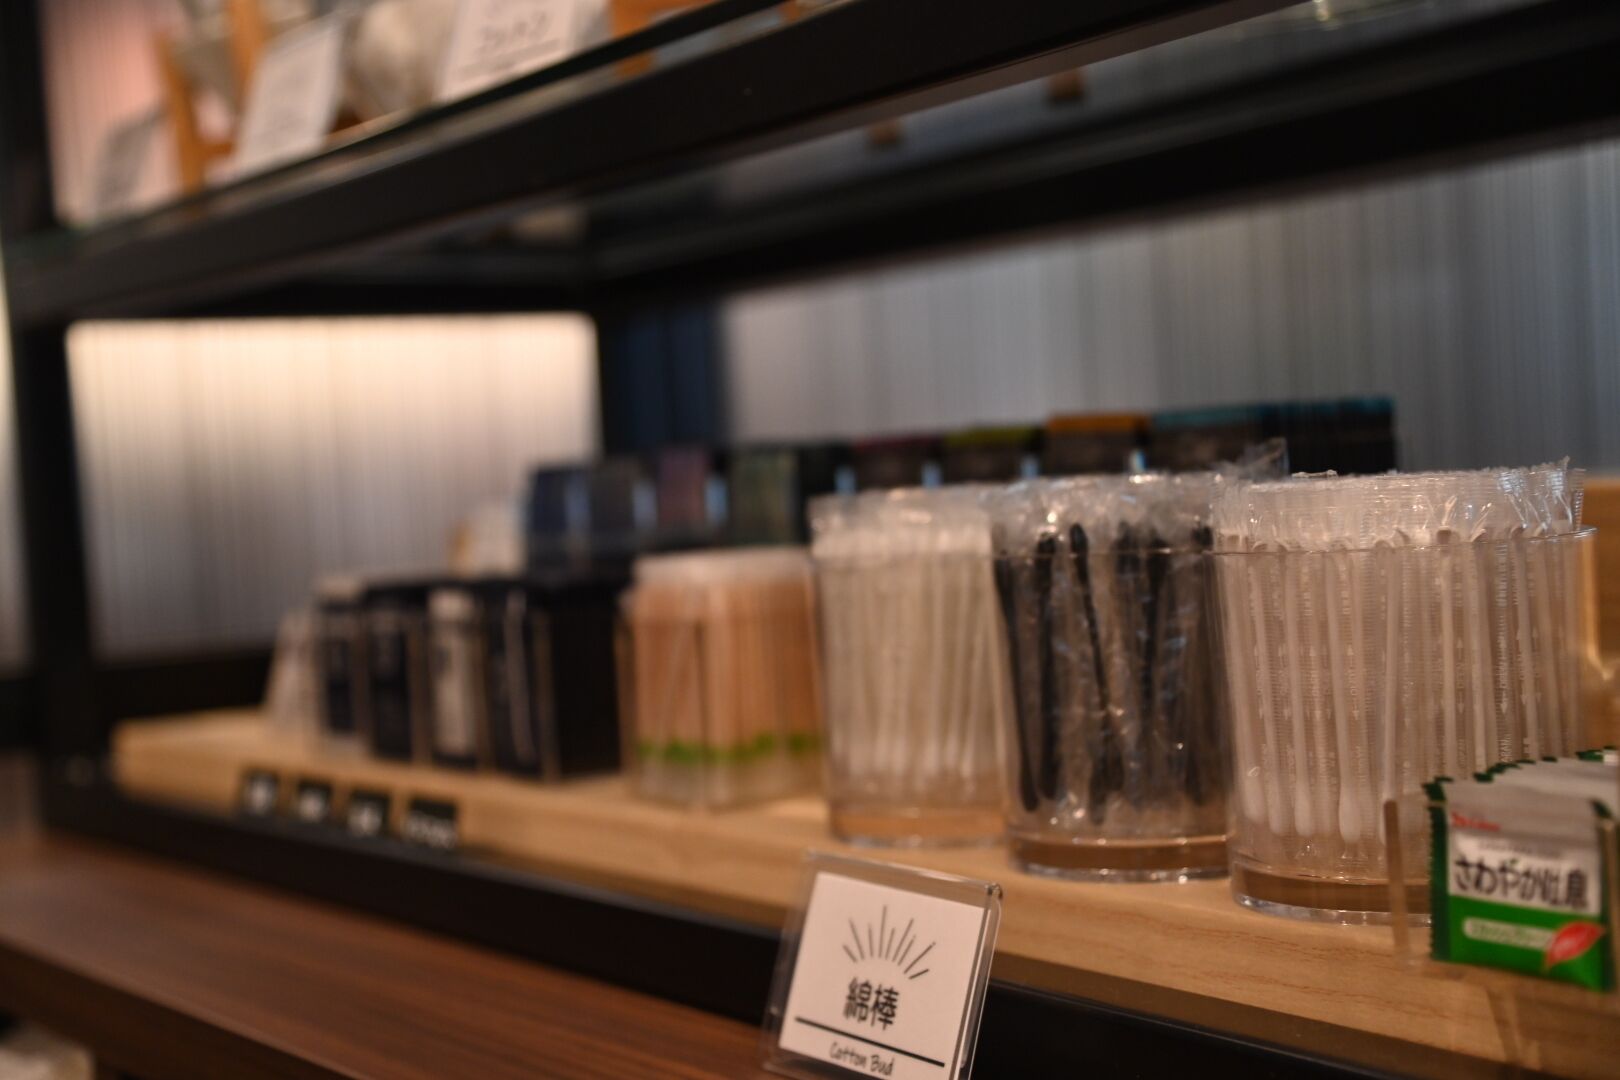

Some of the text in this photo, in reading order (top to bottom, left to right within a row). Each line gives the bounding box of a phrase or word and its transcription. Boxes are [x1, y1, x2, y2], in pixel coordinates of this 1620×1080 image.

[843, 977, 899, 1031] 綿棒
[829, 1041, 895, 1076] Cotton Bud
